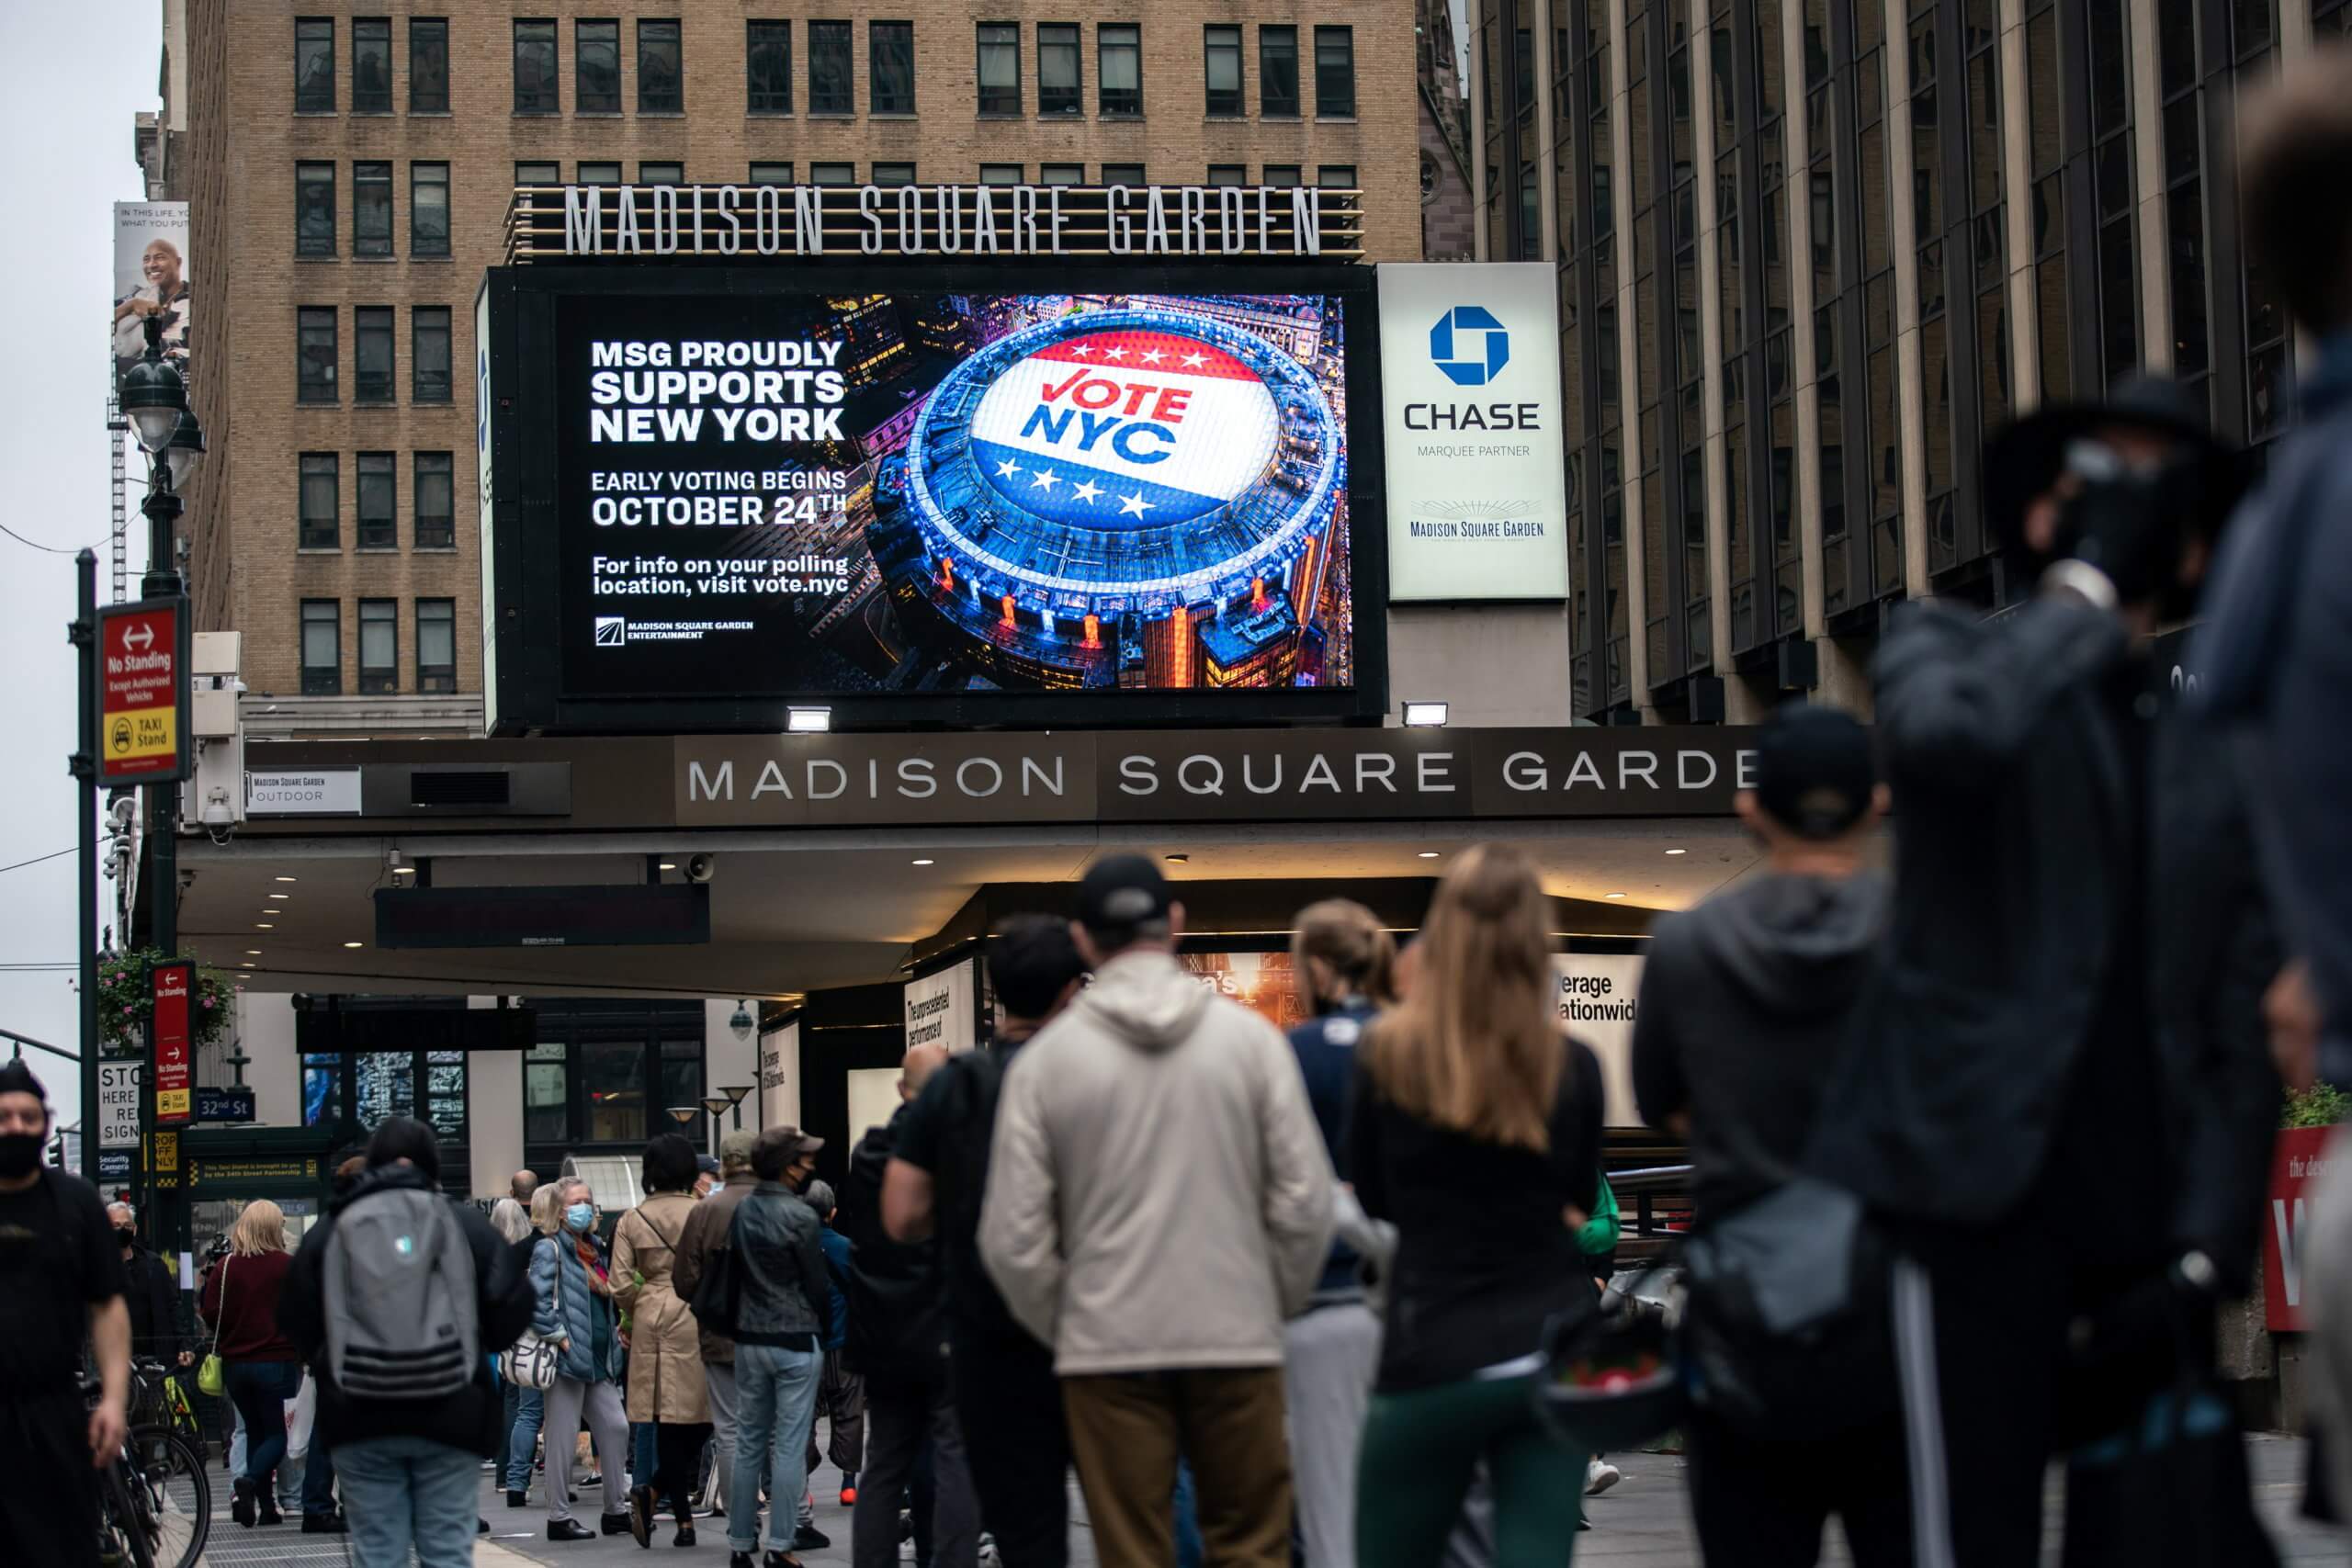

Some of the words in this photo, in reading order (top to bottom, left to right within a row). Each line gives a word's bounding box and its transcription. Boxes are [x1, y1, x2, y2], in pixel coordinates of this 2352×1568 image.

[565, 185, 823, 256] MADISON
[860, 185, 1070, 256] SQUARE
[1107, 185, 1321, 256] GARDEN
[592, 341, 673, 367] MSG
[681, 340, 842, 367] PROUDLY
[591, 370, 845, 404] SUPPORTS
[1040, 368, 1193, 423] VOTE
[591, 408, 704, 443] NEW
[712, 408, 845, 442] YORK
[1404, 403, 1542, 431] CHASE
[1020, 404, 1177, 465] NYC
[1418, 446, 1475, 457] MARQUEE
[1479, 446, 1530, 457] PARTNER
[592, 471, 663, 491] EARLY
[669, 471, 755, 491] VOTING
[762, 470, 846, 491] BEGINS
[592, 496, 764, 526] OCTOBER
[774, 494, 846, 525] 24TH
[1410, 521, 1457, 537] MADISON
[1461, 520, 1500, 537] SQUARE
[1503, 520, 1544, 536] GARDEN
[593, 557, 629, 574] For
[635, 556, 678, 574] info
[684, 559, 711, 574] on
[717, 558, 767, 576] your
[773, 555, 849, 576] polling
[593, 576, 692, 597] location,
[697, 575, 747, 594] visit
[752, 576, 849, 595] vote.nyc
[628, 622, 673, 631] MADISON
[674, 622, 714, 631] SQUARE
[715, 621, 753, 630] GARDEN
[628, 631, 704, 639] ENTERTAINMENT
[108, 656, 122, 673] No
[125, 651, 171, 671] Standing
[110, 681, 131, 692] Except
[132, 675, 171, 689] Authorized
[126, 691, 153, 703] Vehicles
[139, 718, 163, 731] TAXI
[138, 731, 166, 747] Stand
[254, 778, 279, 786] MADISON
[280, 777, 302, 787] SQUARE
[303, 777, 325, 786] GARDEN
[688, 756, 1065, 802] MADISON
[1118, 751, 1456, 796] SQUARE
[1502, 749, 1759, 792] GARDE
[256, 791, 323, 802] OUTDOOR
[1560, 976, 1612, 998] erage
[102, 1090, 135, 1104] HERE
[117, 1107, 140, 1121] RE
[201, 1099, 230, 1115] 32nd
[232, 1100, 248, 1115] St
[155, 1146, 172, 1156] FF
[99, 1155, 130, 1165] Security
[99, 1163, 130, 1171] Camera
[2290, 1156, 2304, 1178] the
